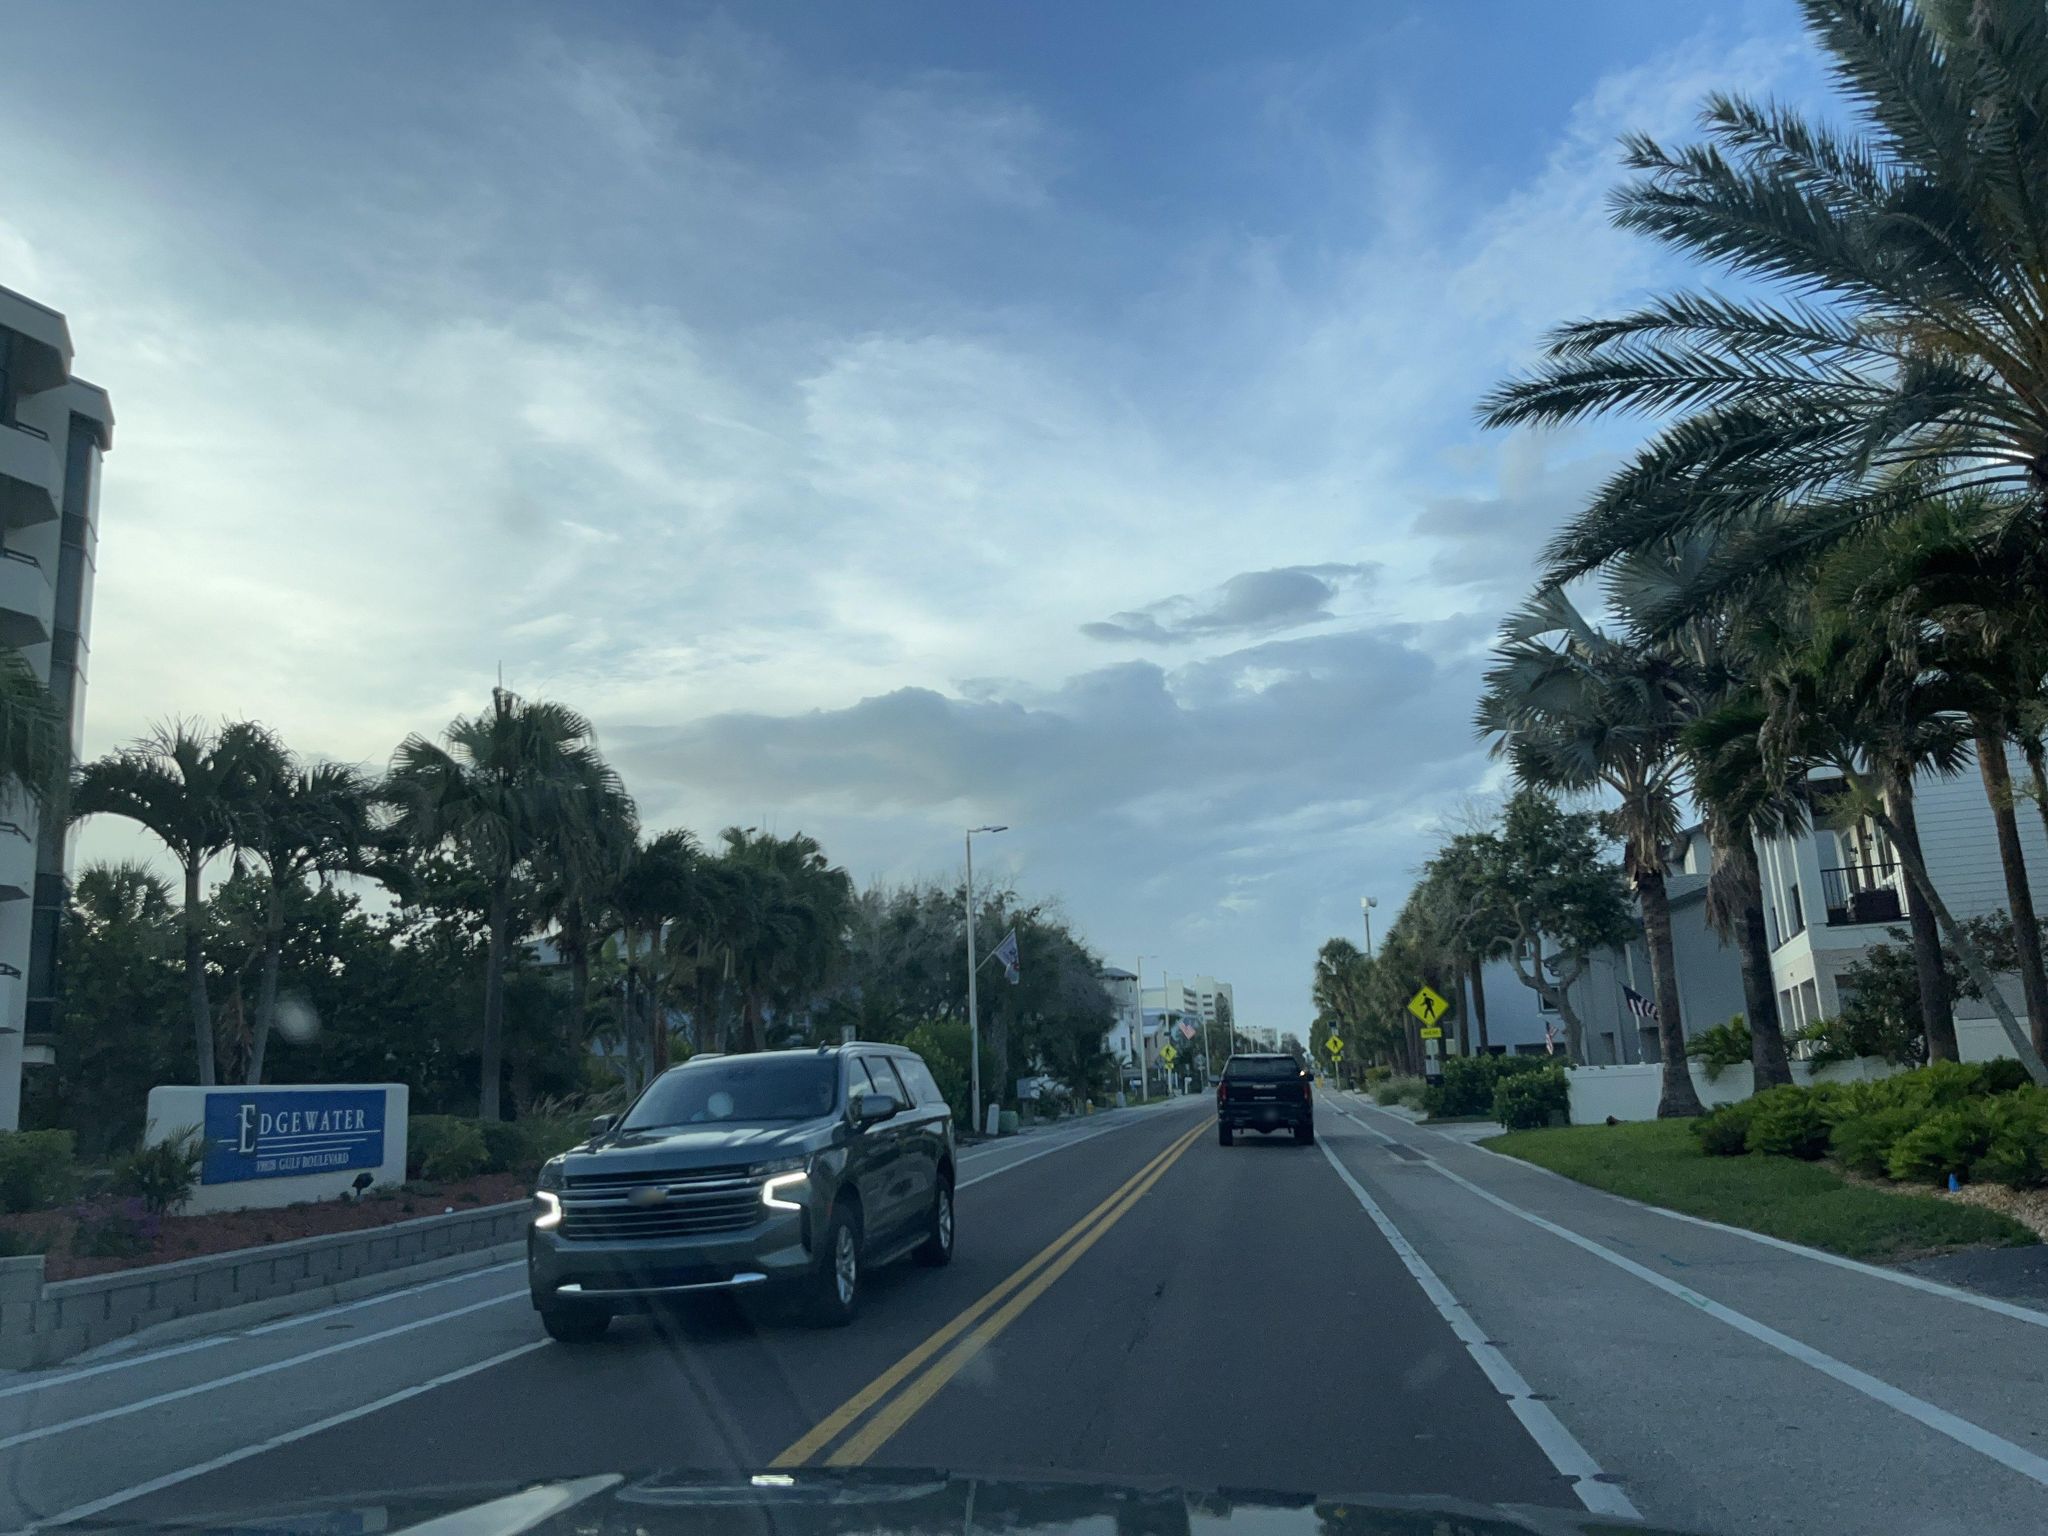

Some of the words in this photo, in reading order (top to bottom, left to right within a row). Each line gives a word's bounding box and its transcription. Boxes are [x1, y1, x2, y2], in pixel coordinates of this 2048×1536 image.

[237, 1104, 366, 1153] EDGEWATER
[279, 1156, 300, 1170] GULF
[302, 1152, 350, 1168] BOULEVARD
